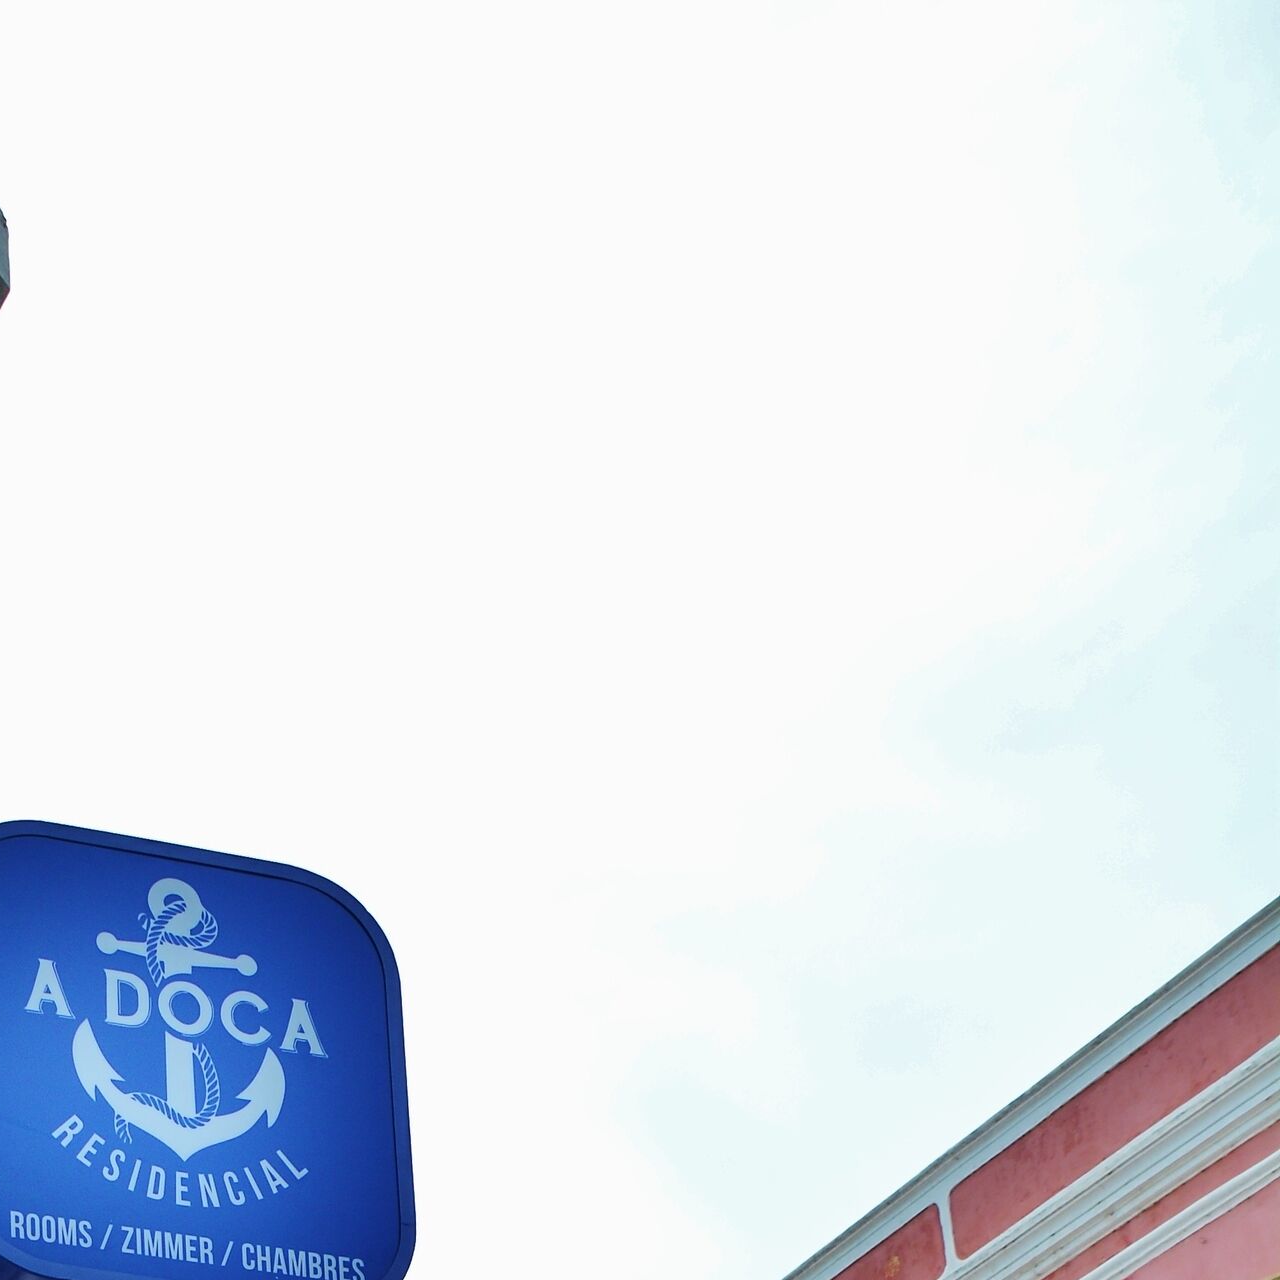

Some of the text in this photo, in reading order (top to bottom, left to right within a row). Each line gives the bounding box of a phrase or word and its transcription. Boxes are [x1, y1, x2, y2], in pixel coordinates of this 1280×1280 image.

[24, 958, 328, 1058] A DOCA
[51, 1114, 309, 1208] RESIDENCIAL
[10, 1210, 93, 1249] ROOMS
[121, 1225, 214, 1266] ZIMMER
